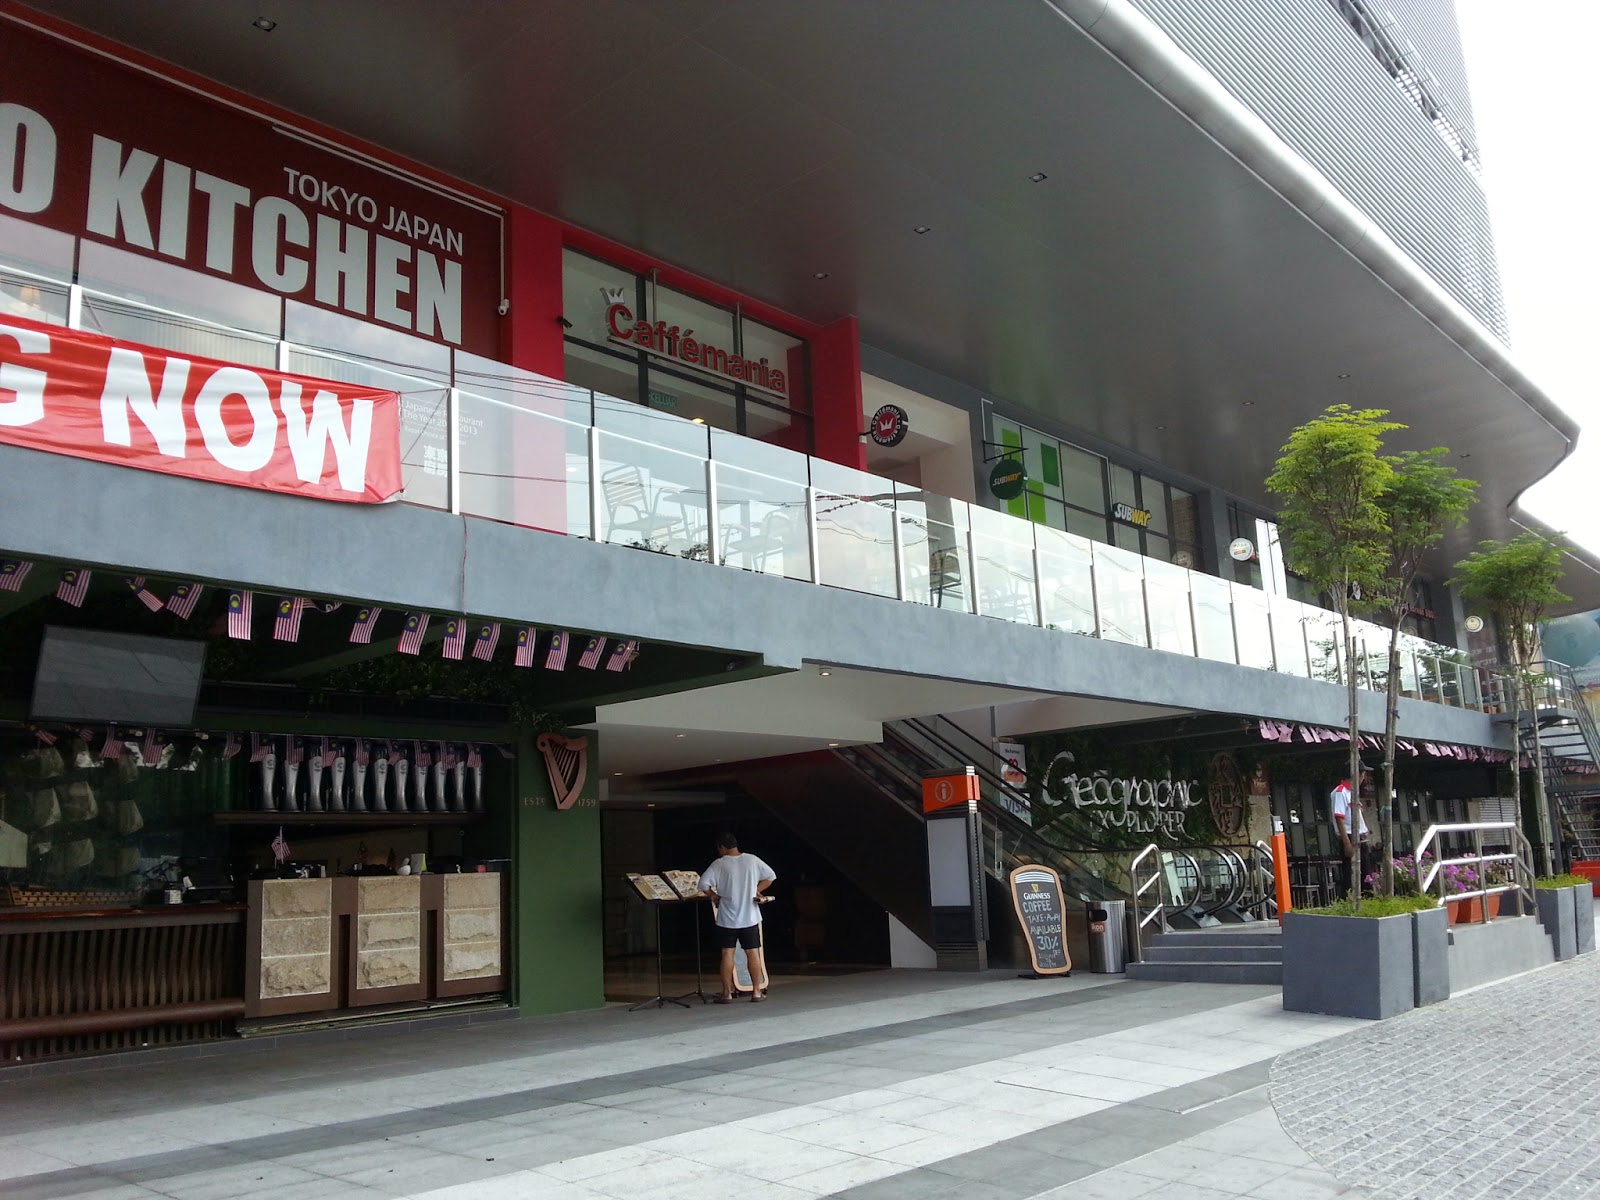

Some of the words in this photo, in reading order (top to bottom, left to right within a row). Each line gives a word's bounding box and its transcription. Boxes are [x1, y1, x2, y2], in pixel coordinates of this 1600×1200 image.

[283, 166, 377, 223] TOKYO
[382, 204, 463, 256] JAPAN
[86, 133, 463, 345] KITCHEN
[606, 303, 786, 393] Caffémania
[99, 346, 374, 493] NOW
[992, 472, 1022, 486] SUBWAY
[1114, 502, 1152, 527] SUBWAY
[578, 799, 596, 807] 1759
[1003, 798, 1027, 814] VISA
[1023, 892, 1051, 900] GUINNESS
[1022, 900, 1052, 913] COFFEE
[1030, 923, 1062, 935] AVAILABLE
[1036, 936, 1059, 950] 30%
